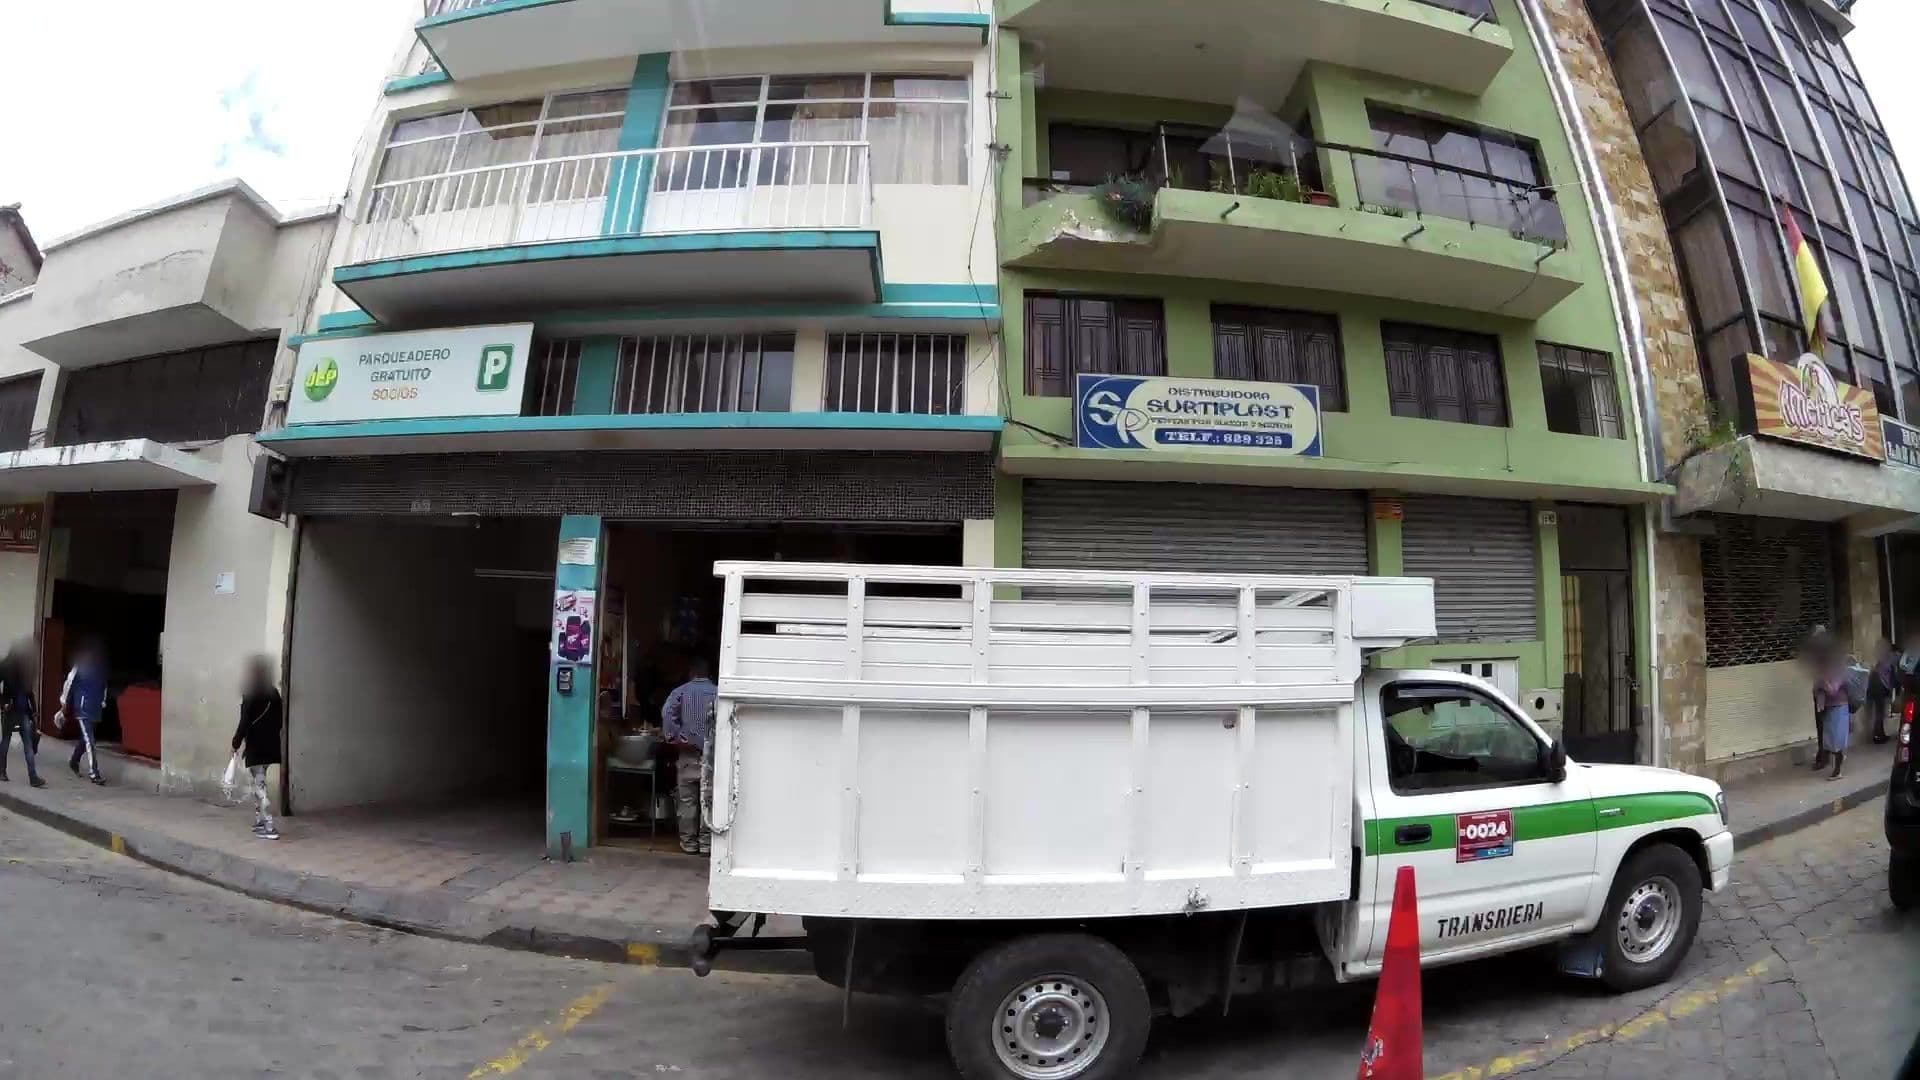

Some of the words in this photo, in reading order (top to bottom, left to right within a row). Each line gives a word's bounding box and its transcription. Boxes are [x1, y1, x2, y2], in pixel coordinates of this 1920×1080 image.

[359, 348, 450, 366] PARQUEADERO
[370, 367, 432, 382] GRATUITO
[372, 387, 418, 400] SOCIOS
[1168, 387, 1270, 400] DISTRIBUIDORA
[1147, 399, 1295, 420] SURTIPLAST
[1466, 821, 1508, 839] 0024
[1438, 901, 1543, 938] TRANSRIERA
